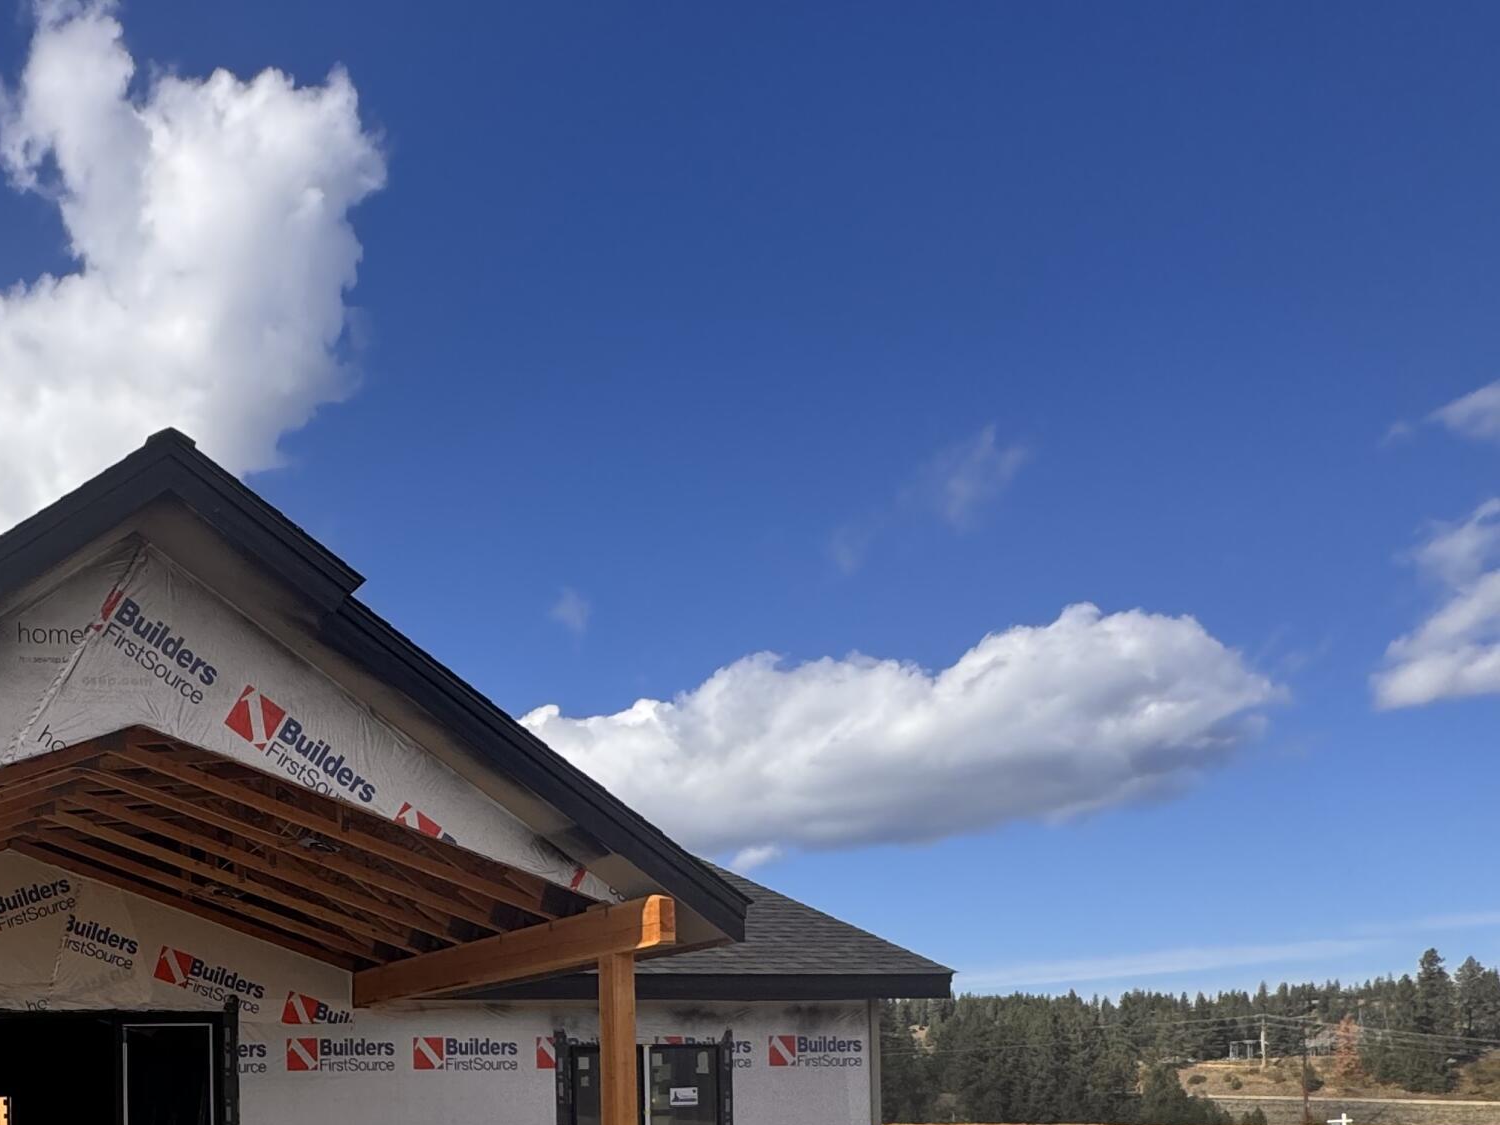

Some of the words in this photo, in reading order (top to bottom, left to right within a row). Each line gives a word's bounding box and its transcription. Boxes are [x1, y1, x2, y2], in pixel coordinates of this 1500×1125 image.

[114, 597, 218, 686] Builders
[102, 624, 204, 705] FirstSource
[278, 716, 376, 803] Builders
[65, 938, 133, 970] irstSource
[189, 958, 265, 1000] Builders
[185, 977, 260, 1014] FirstSrce
[315, 1002, 352, 1024] Buil
[319, 1037, 395, 1057] Builders
[445, 1037, 518, 1056] Builders
[796, 1035, 862, 1053] Builders
[320, 1058, 395, 1072] FirstSource
[445, 1057, 518, 1071] FirstSource
[796, 1054, 862, 1068] FirstSource
